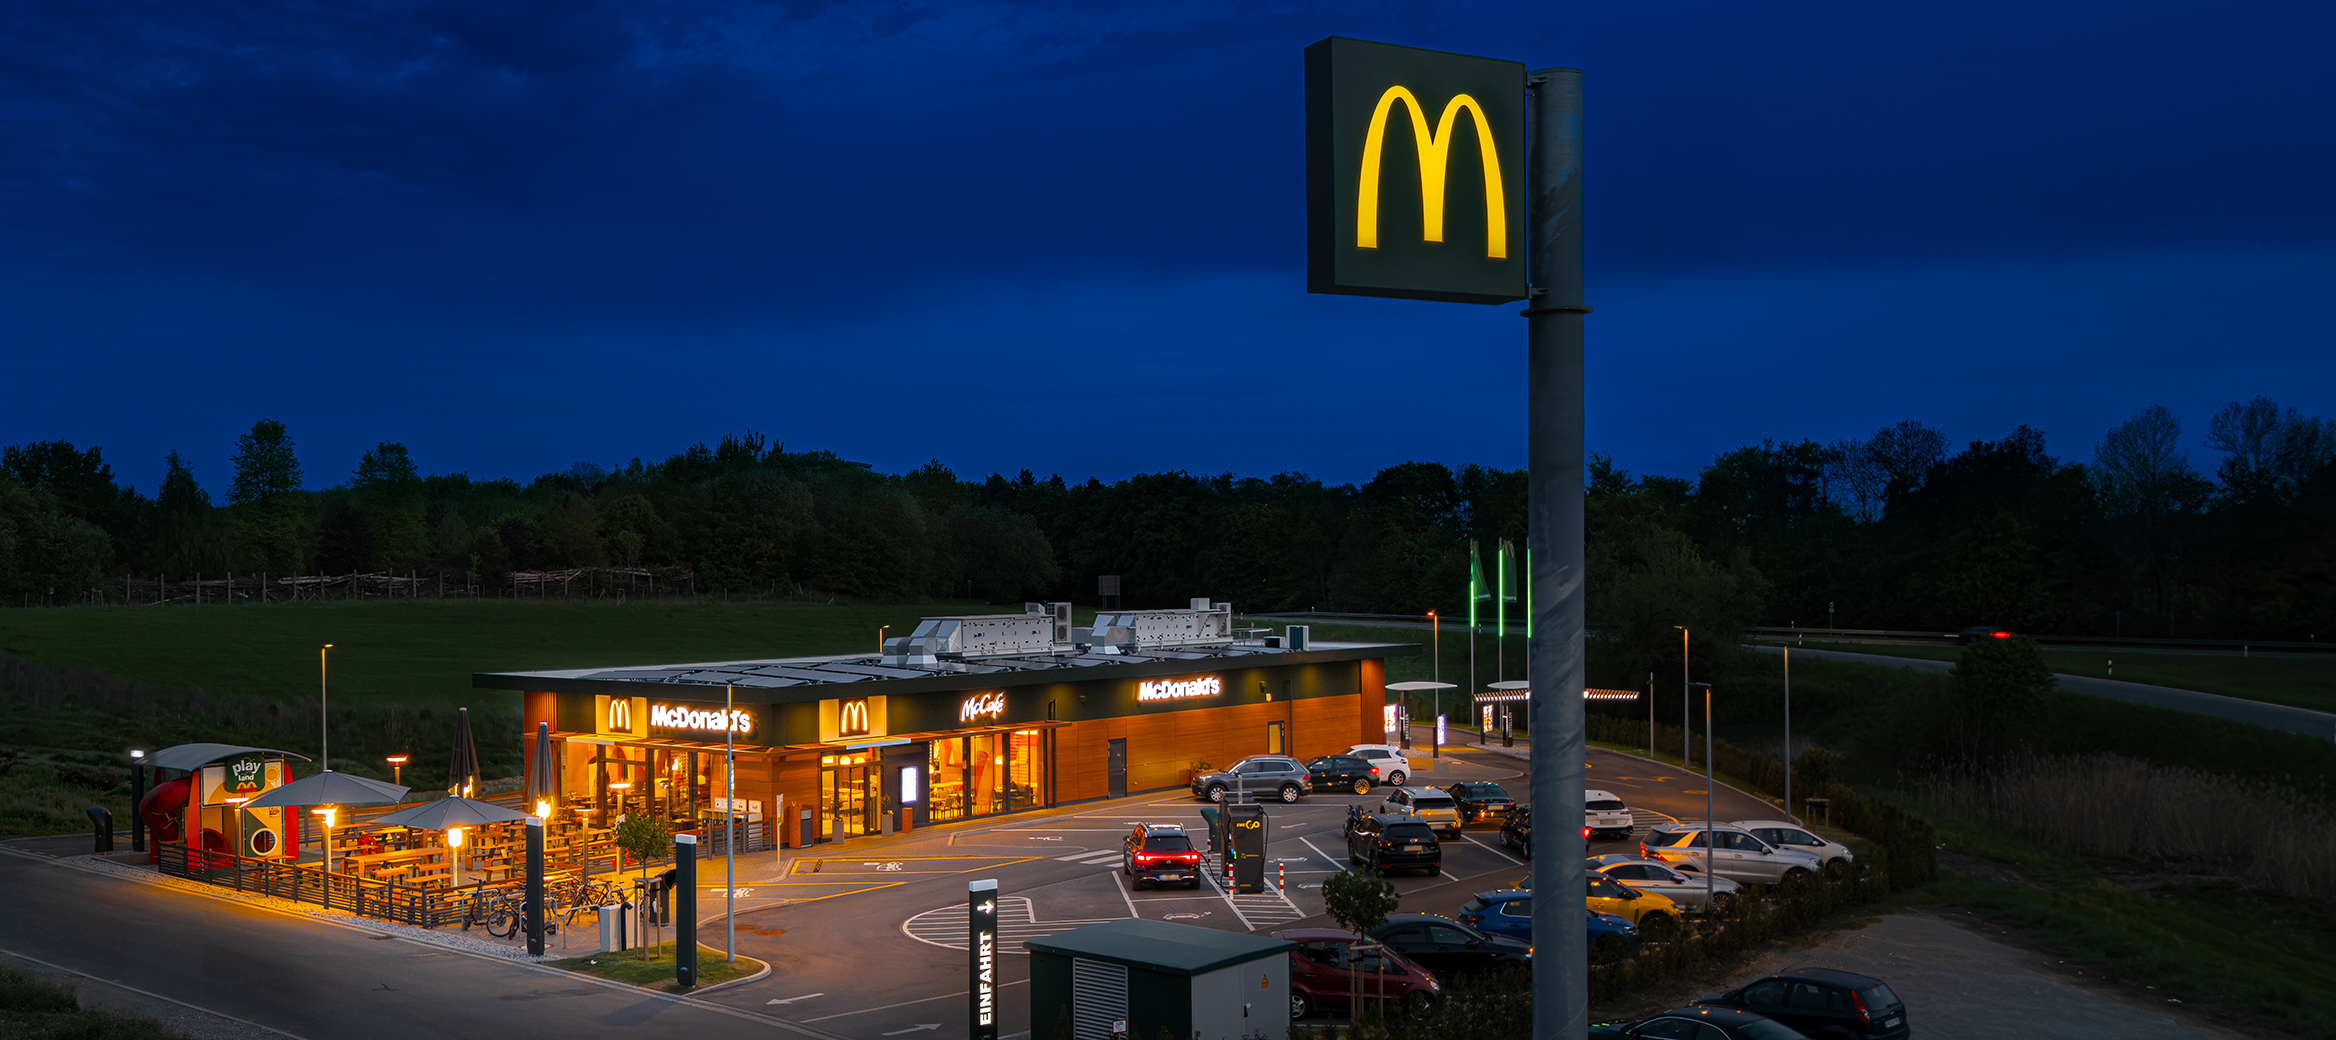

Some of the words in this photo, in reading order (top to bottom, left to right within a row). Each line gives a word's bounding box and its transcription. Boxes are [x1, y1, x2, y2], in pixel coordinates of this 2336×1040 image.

[1139, 677, 1220, 700] McDonald's
[961, 692, 1004, 721] McCafé
[232, 759, 261, 776] play
[979, 931, 992, 1026] EINFAHRT
